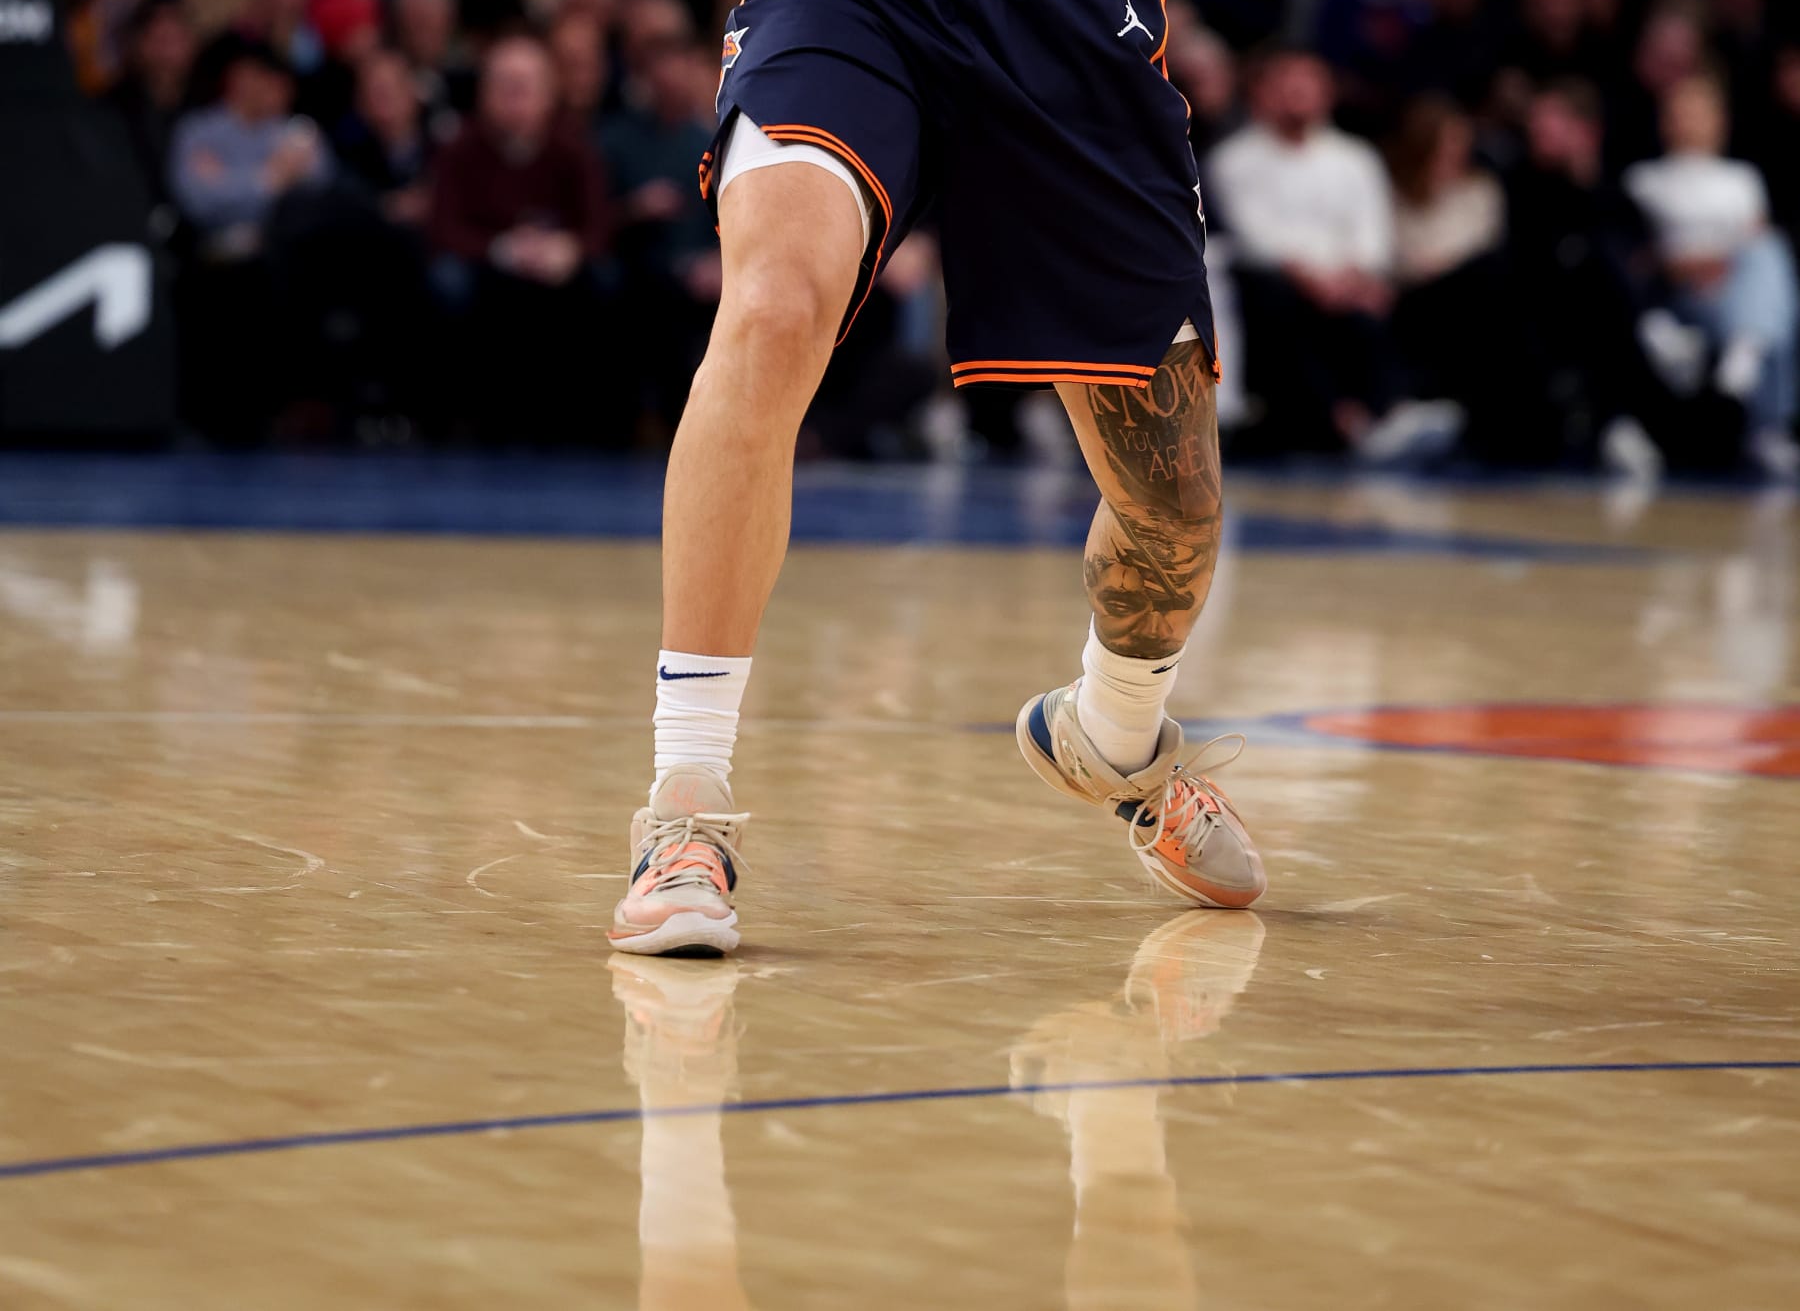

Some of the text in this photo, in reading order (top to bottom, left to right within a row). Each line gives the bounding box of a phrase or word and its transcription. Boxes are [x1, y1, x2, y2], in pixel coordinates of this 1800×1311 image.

[1088, 363, 1212, 428] KNOW
[1118, 428, 1161, 452] YOU
[1148, 435, 1204, 483] ARE
